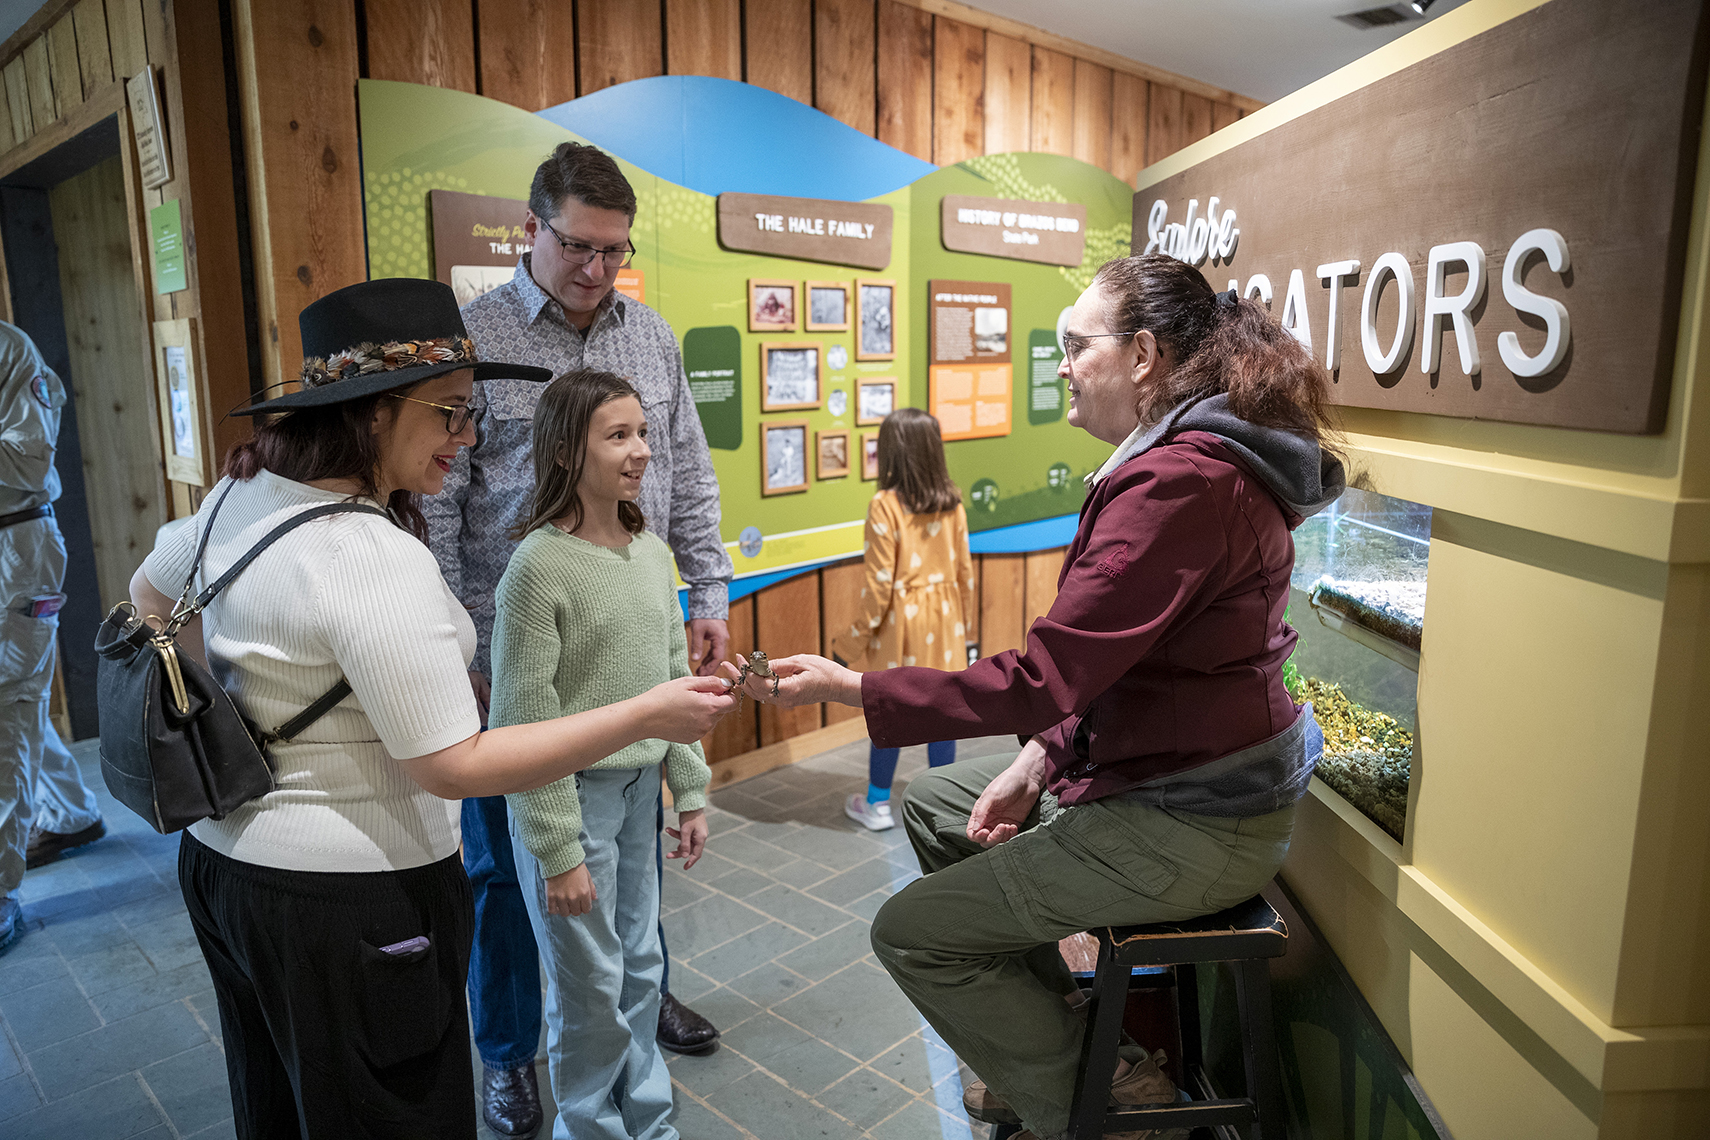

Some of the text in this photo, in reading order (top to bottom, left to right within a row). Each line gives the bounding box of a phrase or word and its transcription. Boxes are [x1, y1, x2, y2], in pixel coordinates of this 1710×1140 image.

[755, 213, 875, 239] THE HALE FAMILY
[958, 208, 1002, 226] HISTORY
[1002, 211, 1017, 227] OF
[471, 223, 510, 244] Strictly
[1143, 196, 1240, 265] Explore
[489, 242, 533, 255] THE HA
[1228, 228, 1570, 378] ATORS
